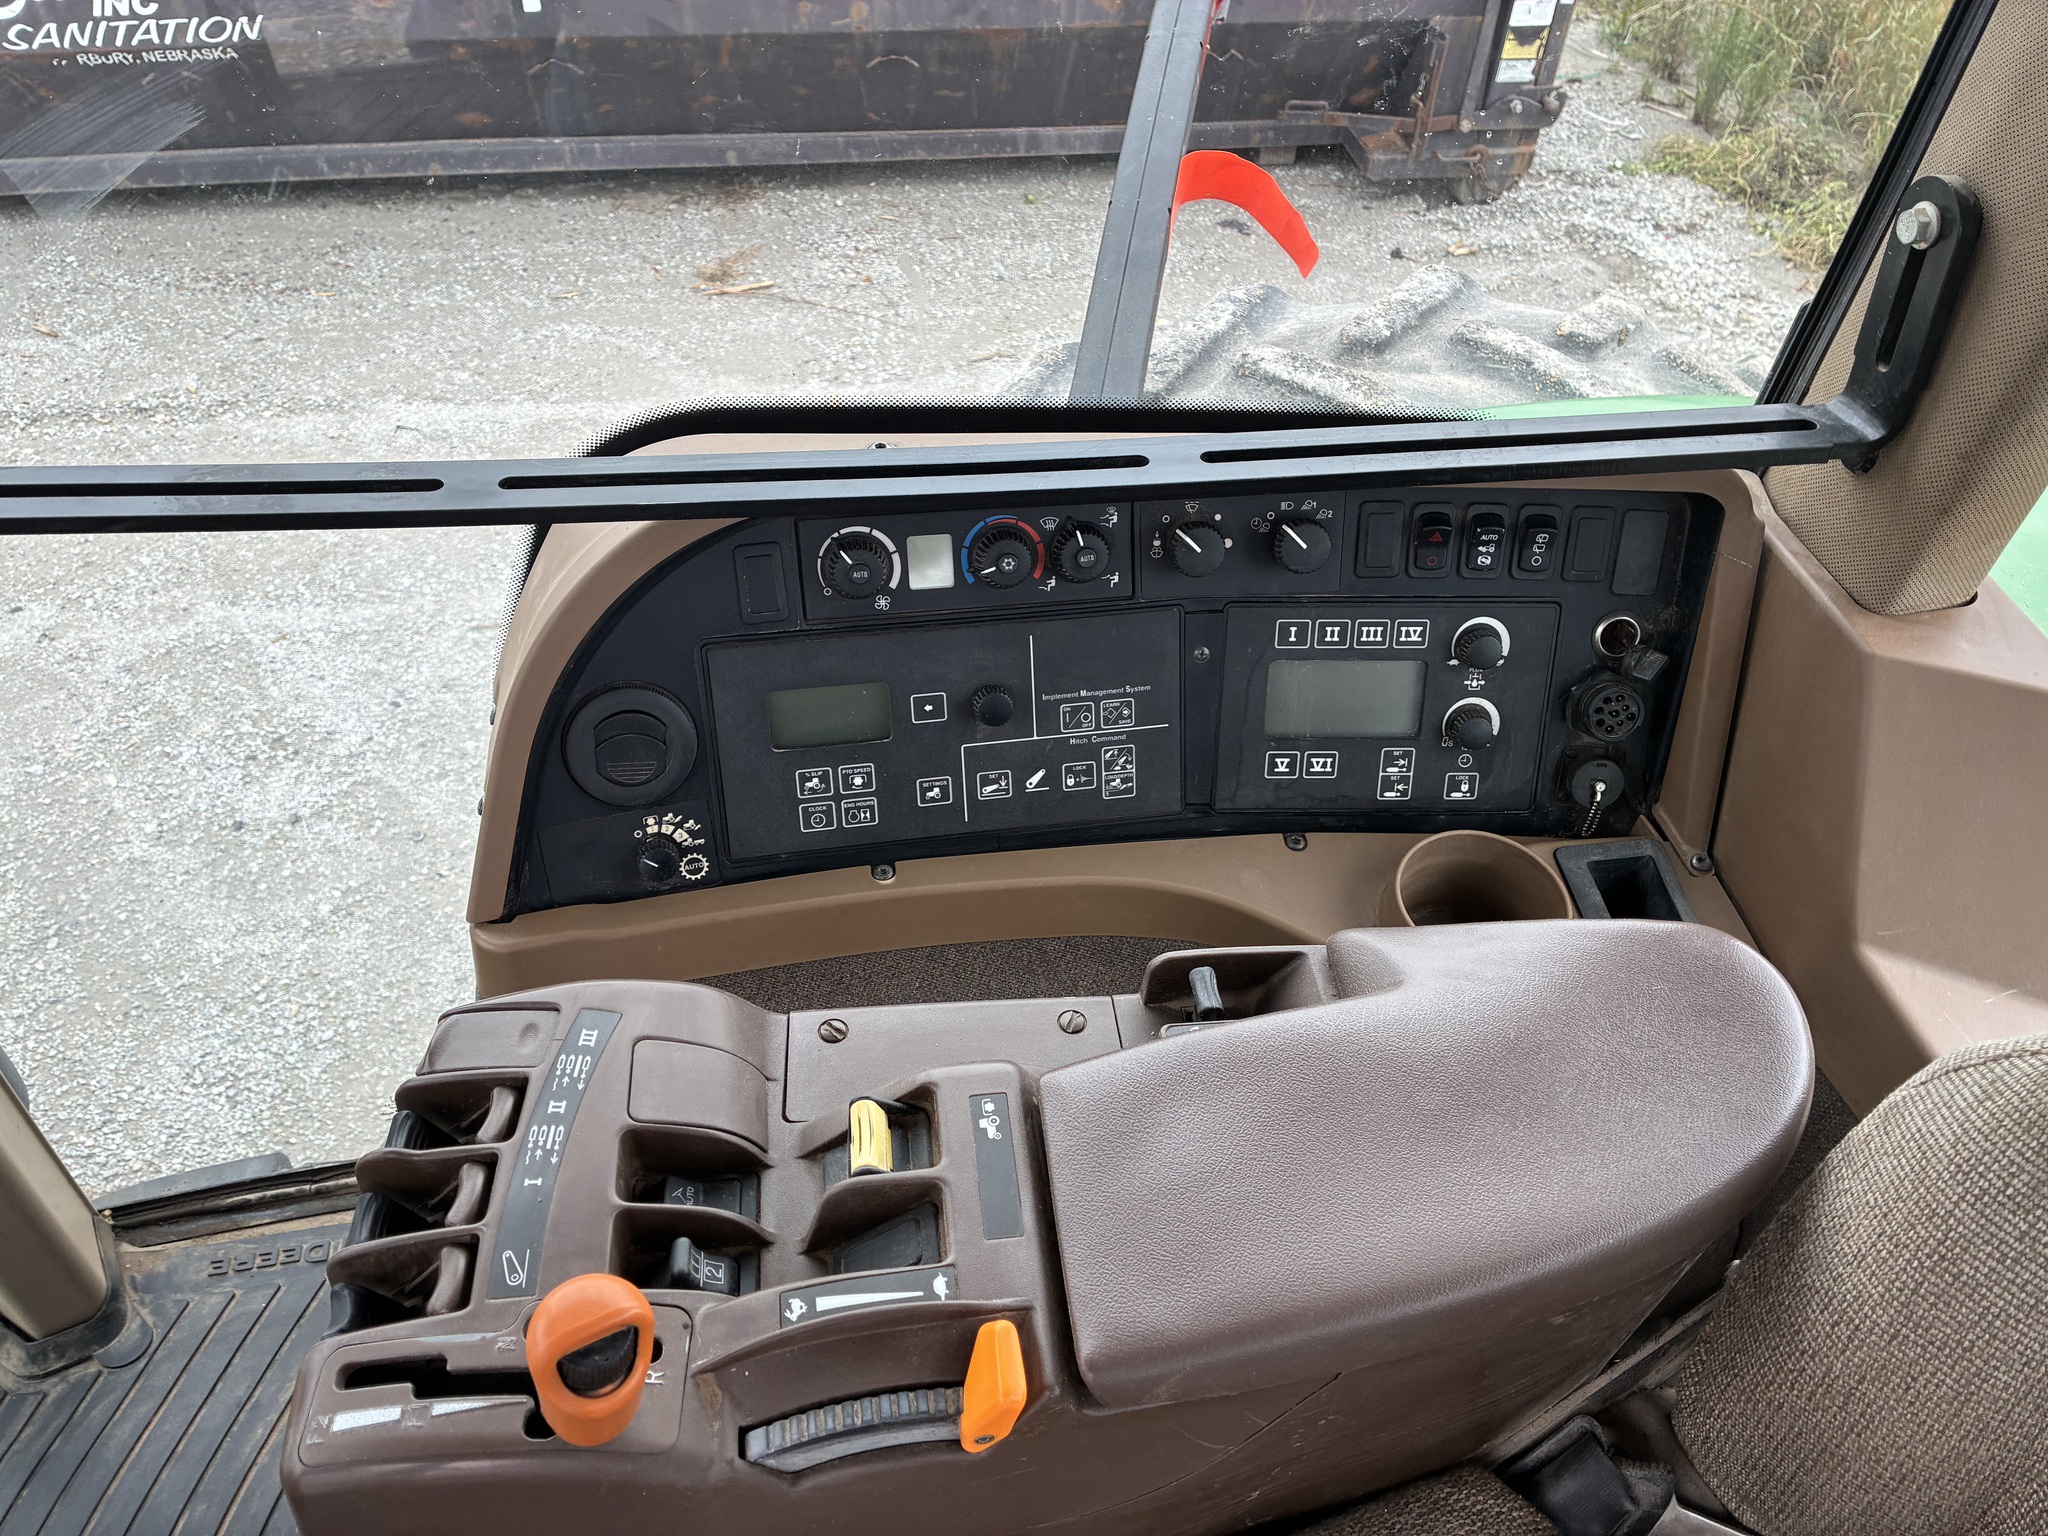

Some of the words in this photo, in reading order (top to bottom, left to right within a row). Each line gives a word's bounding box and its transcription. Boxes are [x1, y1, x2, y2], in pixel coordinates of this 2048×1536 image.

[2, 14, 264, 51] SANITATION
[142, 46, 239, 63] NEBRASKA
[1327, 510, 1333, 518] 2
[1080, 554, 1095, 563] AUTO
[1288, 626, 1297, 642] I
[1324, 626, 1340, 642] II
[1360, 626, 1383, 642] III
[1399, 626, 1423, 642] IV
[1042, 691, 1079, 701] Implement
[1080, 687, 1124, 697] Management
[1125, 684, 1151, 694] System
[1070, 737, 1088, 745] Hitch
[1091, 733, 1126, 743] Command
[1274, 758, 1290, 772] V
[1309, 758, 1333, 772] VI
[922, 780, 948, 788] SETTINGS
[684, 862, 704, 871] AUTO
[578, 1028, 598, 1047] III
[547, 1100, 567, 1114] II
[207, 1240, 332, 1277] DEERE
[705, 1266, 722, 1278] 2
[644, 1370, 665, 1385] R
